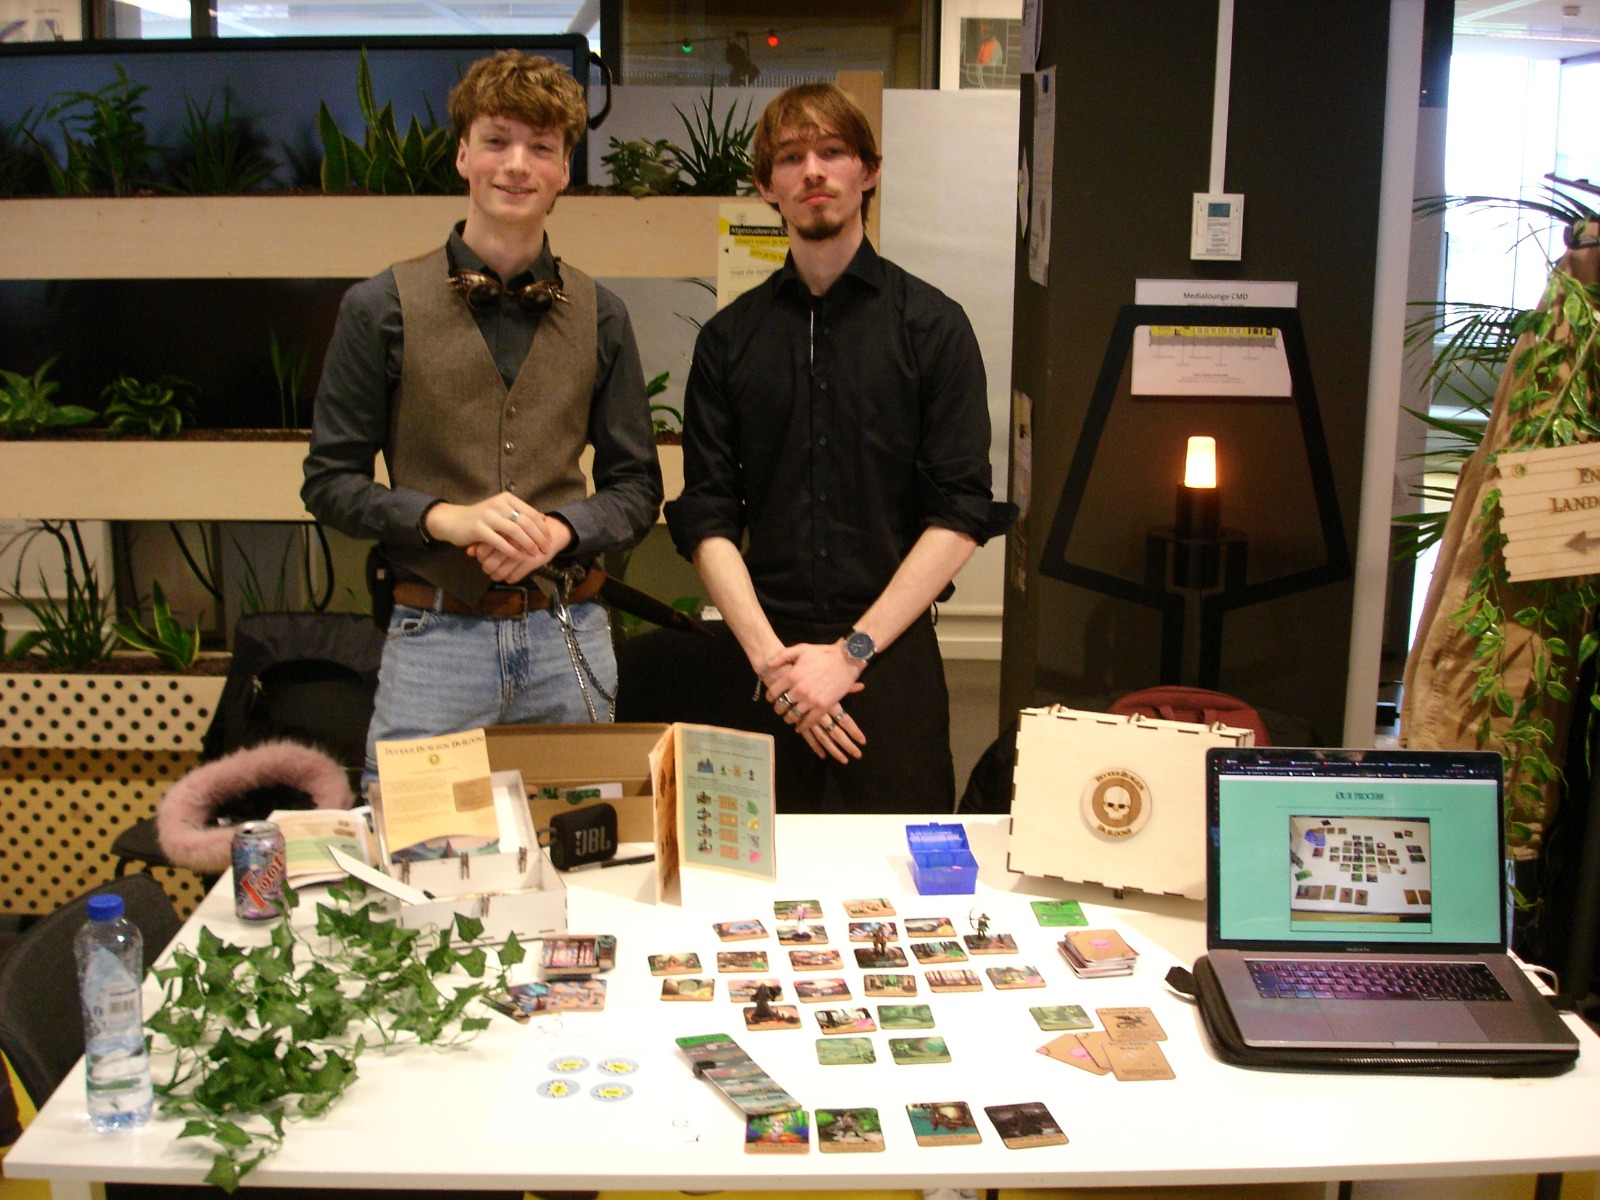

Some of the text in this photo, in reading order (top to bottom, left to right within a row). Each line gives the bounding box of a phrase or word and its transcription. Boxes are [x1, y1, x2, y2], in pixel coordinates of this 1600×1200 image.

[731, 227, 779, 236] Afgestudeerde
[1183, 292, 1249, 301] Medialounge CMD
[1549, 495, 1600, 513] LAND
[1336, 791, 1384, 800] OUR PROCESS
[575, 826, 611, 857] JBL
